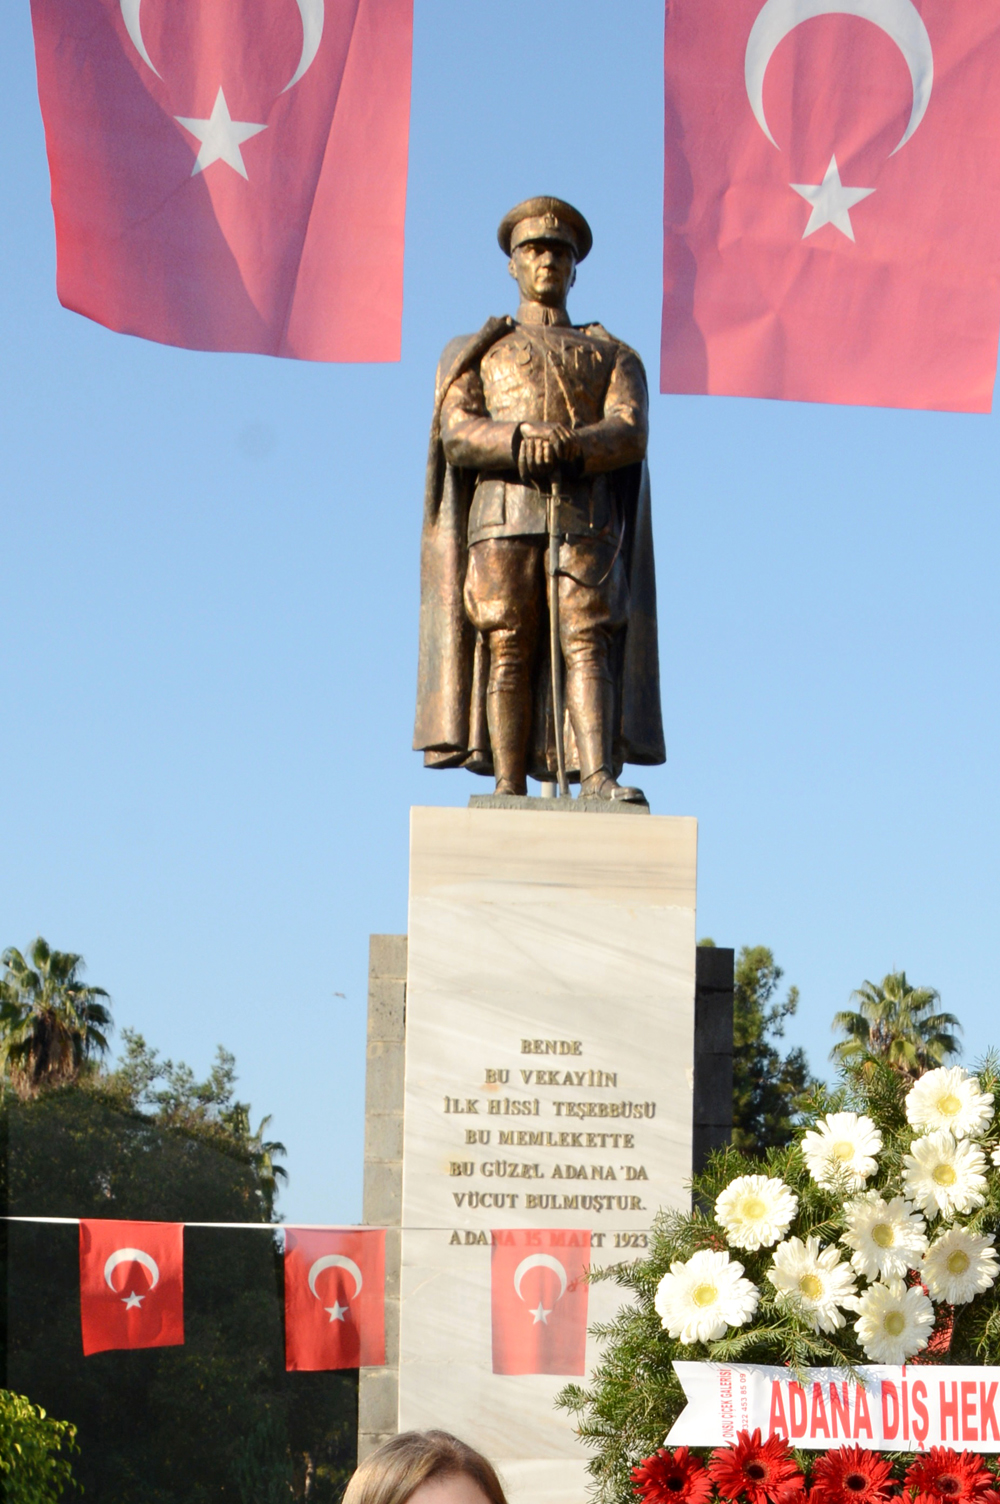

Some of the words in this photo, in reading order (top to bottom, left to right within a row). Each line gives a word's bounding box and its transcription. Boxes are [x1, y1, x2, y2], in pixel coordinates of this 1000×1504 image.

[520, 1038, 583, 1056] BENDE
[485, 1068, 510, 1084] BU
[520, 1069, 618, 1088] VEKAYİİN
[443, 1095, 479, 1114] İLK
[487, 1097, 540, 1116] HİSSİ
[552, 1100, 656, 1120] TEŞEBBÜSÜ
[465, 1128, 491, 1145] BU
[498, 1130, 635, 1149] MEMLEKETTE
[450, 1161, 475, 1177] BU
[479, 1160, 544, 1179] GÜZEL
[452, 1191, 519, 1209] VÜCUT
[525, 1193, 647, 1213] BULMUŞTUR.
[448, 1230, 517, 1247] ADANA
[524, 1231, 542, 1247] 15
[550, 1231, 606, 1248] MART
[613, 1232, 650, 1248] 1923
[717, 1368, 733, 1398] GALERİSİ
[739, 1373, 747, 1383] 09
[740, 1385, 747, 1395] 85
[740, 1397, 748, 1412] 453
[769, 1380, 874, 1439] ADANA
[881, 1365, 929, 1451] DİŞ
